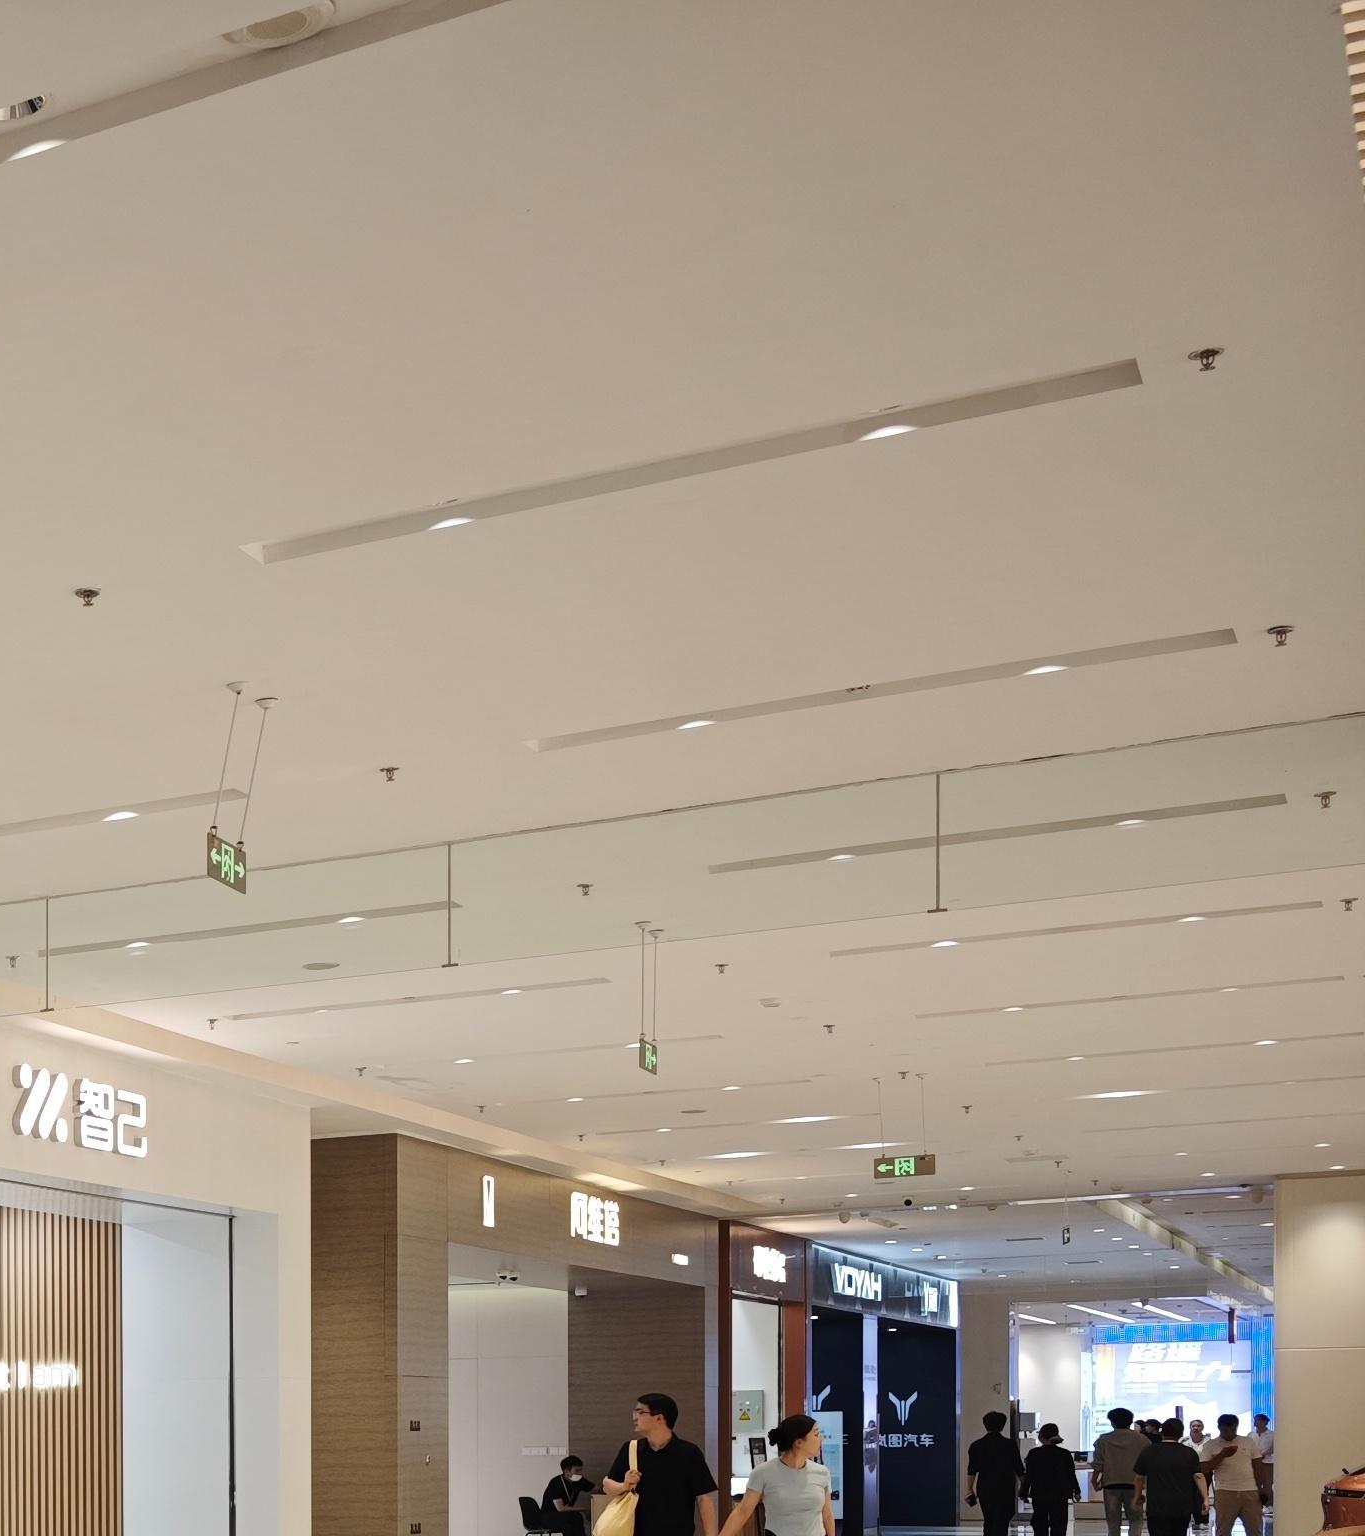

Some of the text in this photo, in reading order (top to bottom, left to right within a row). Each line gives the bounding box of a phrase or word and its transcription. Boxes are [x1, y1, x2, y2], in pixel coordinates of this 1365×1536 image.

[76, 1078, 148, 1158] 智己
[831, 1262, 882, 1302] VOYAH
[32, 1363, 77, 1388] am
